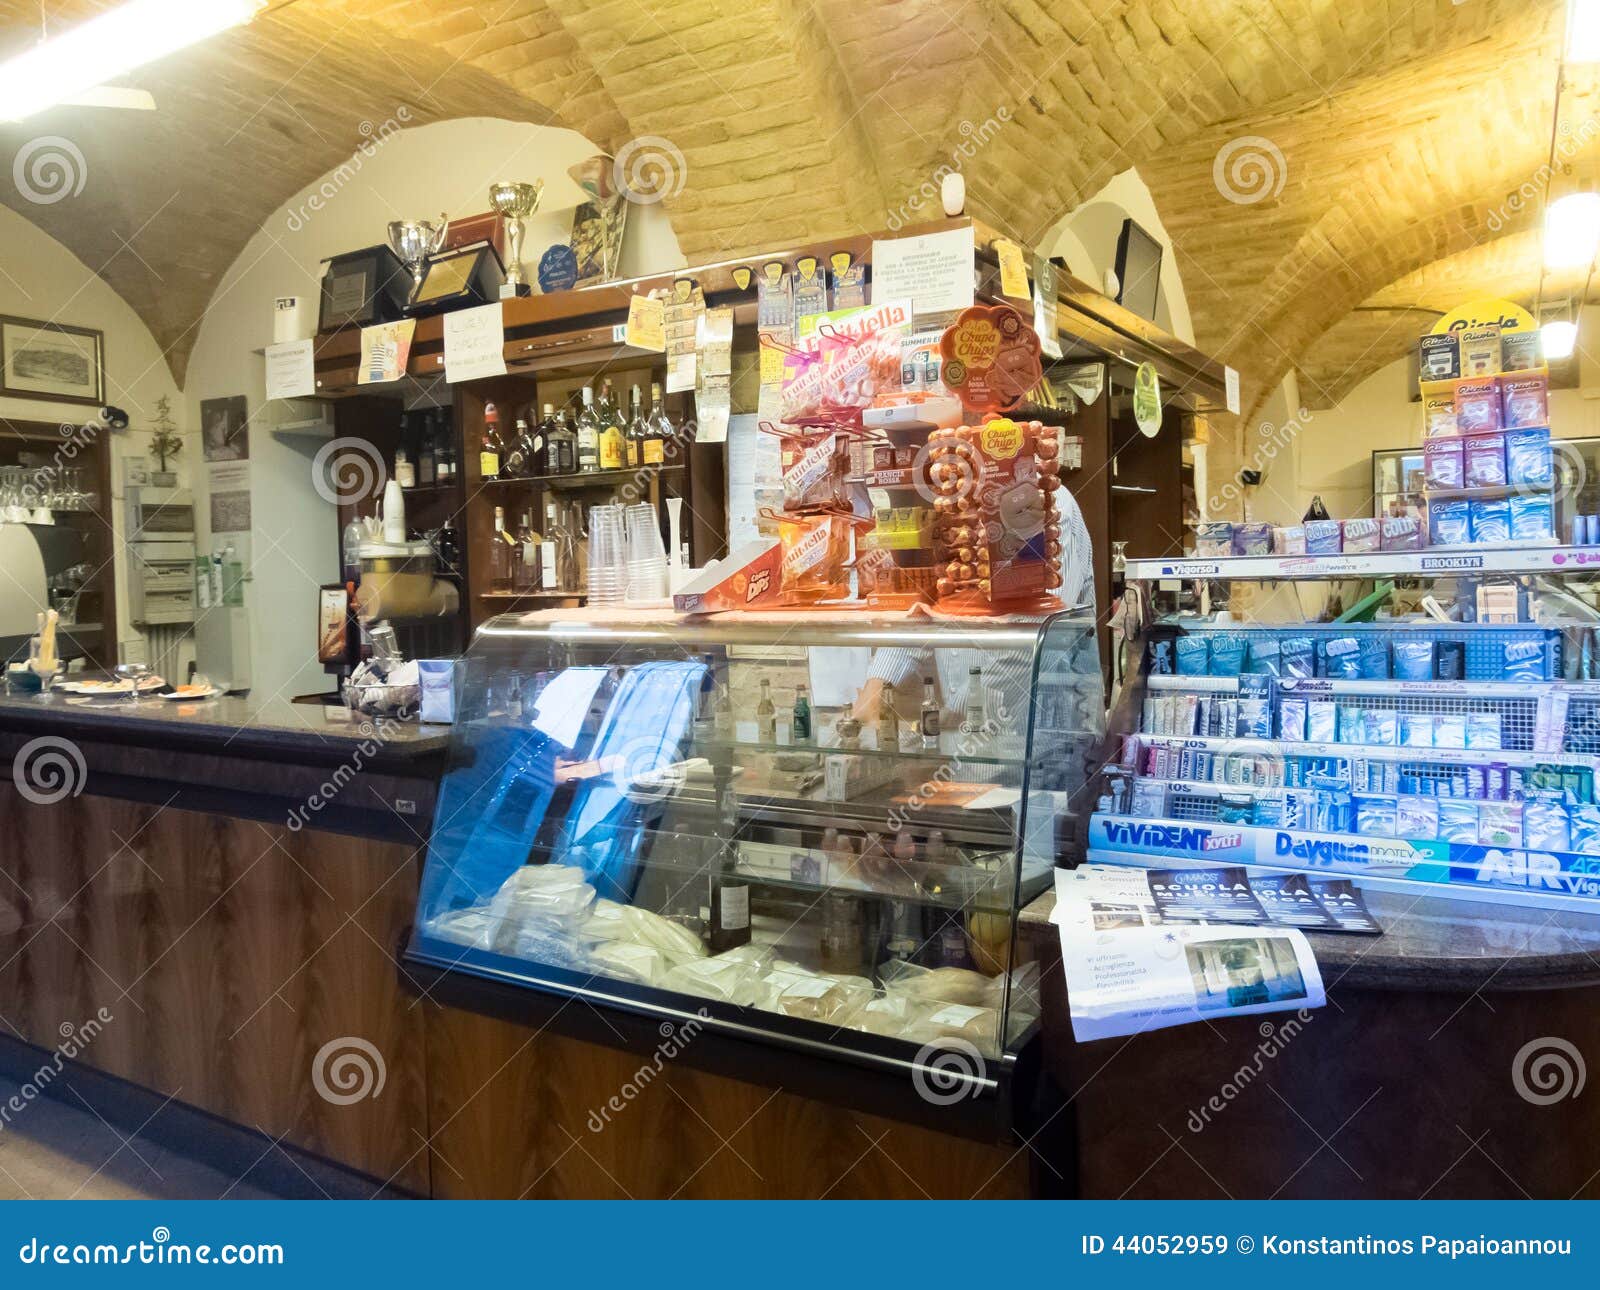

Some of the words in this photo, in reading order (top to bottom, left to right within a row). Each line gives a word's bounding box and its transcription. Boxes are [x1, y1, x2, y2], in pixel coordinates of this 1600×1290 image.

[959, 331, 996, 343] Chupa
[1463, 331, 1496, 343] Ricola
[1424, 556, 1482, 569] BROOKLYN
[1171, 563, 1217, 576] Vigorsol
[1240, 687, 1268, 695] HALLS
[1276, 832, 1369, 866] Daygum
[1476, 849, 1563, 890] AIR
[1153, 883, 1248, 892] SCUOLA
